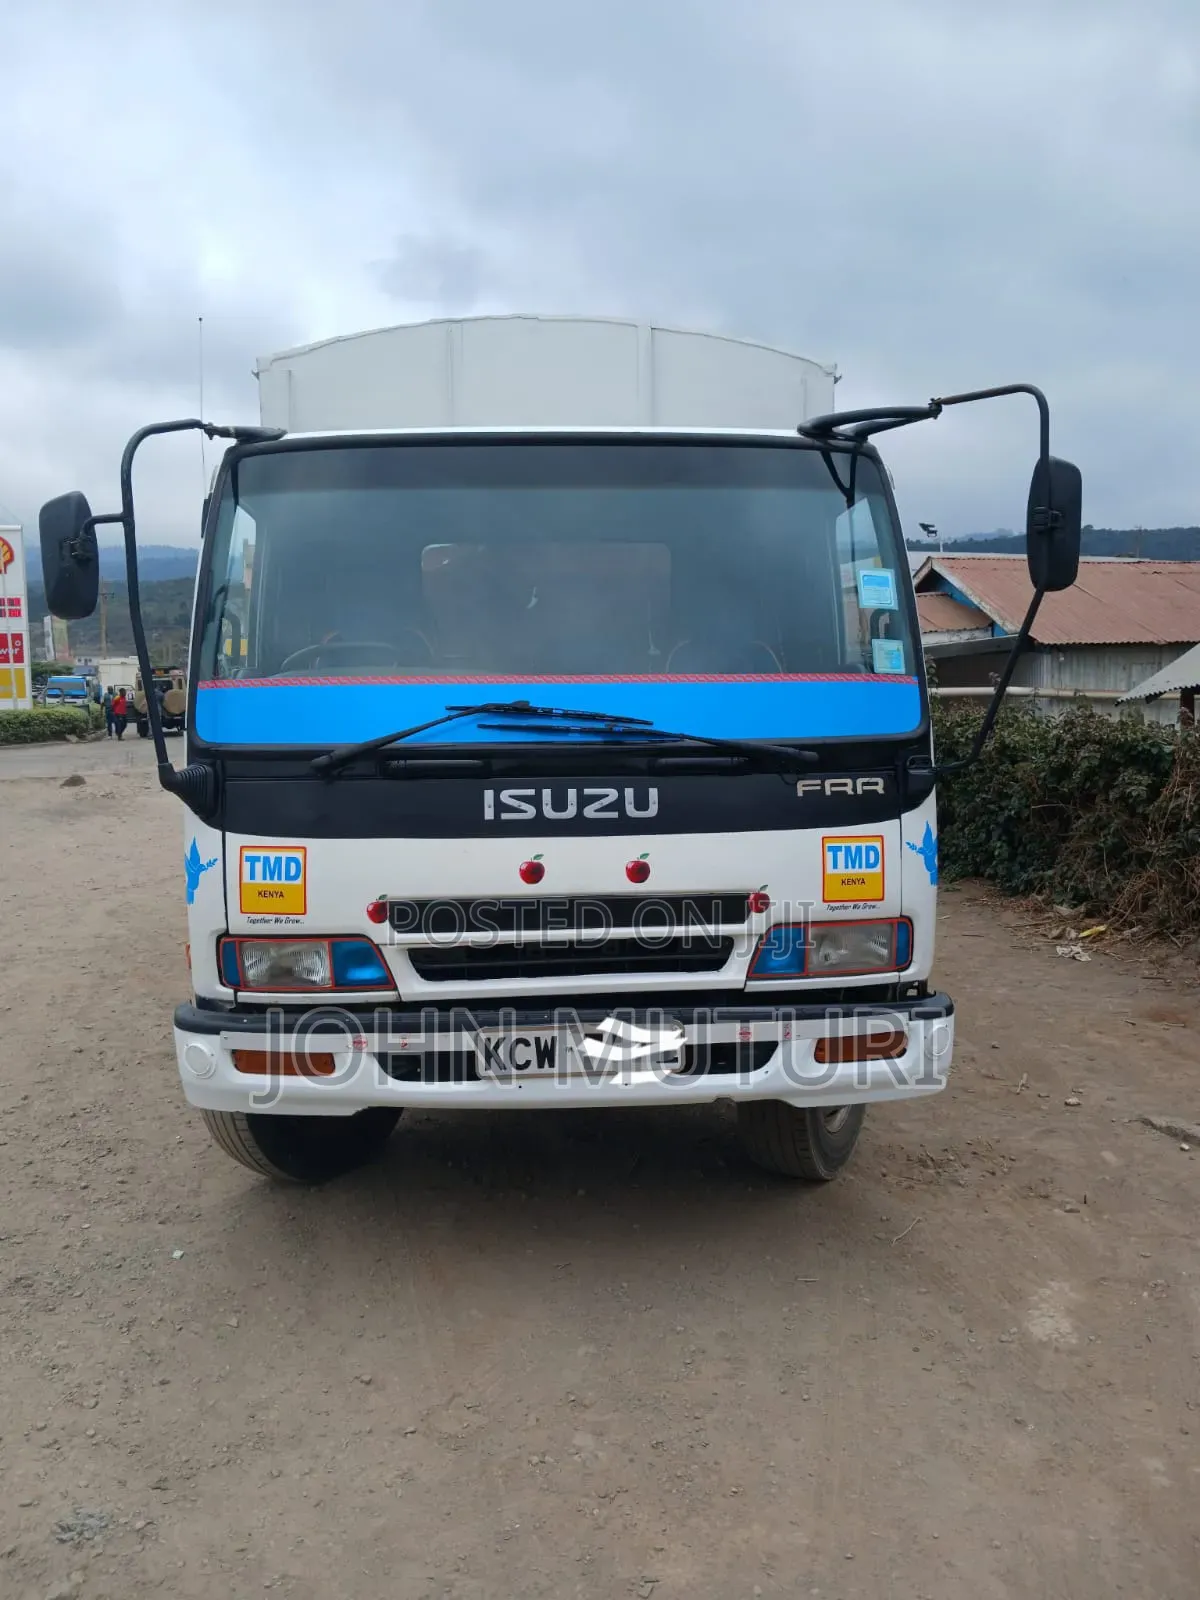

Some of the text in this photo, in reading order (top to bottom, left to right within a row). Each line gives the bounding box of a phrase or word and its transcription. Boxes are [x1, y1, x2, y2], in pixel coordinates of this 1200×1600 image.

[796, 777, 885, 797] FRR
[483, 787, 659, 821] ISUZU
[826, 845, 880, 870] TMD
[244, 855, 302, 882] TMD
[841, 878, 866, 886] KENYA
[257, 890, 285, 899] KENYA
[826, 904, 852, 912] Together
[246, 916, 273, 925] Together
[273, 917, 284, 925] We
[484, 1035, 558, 1071] KCW
